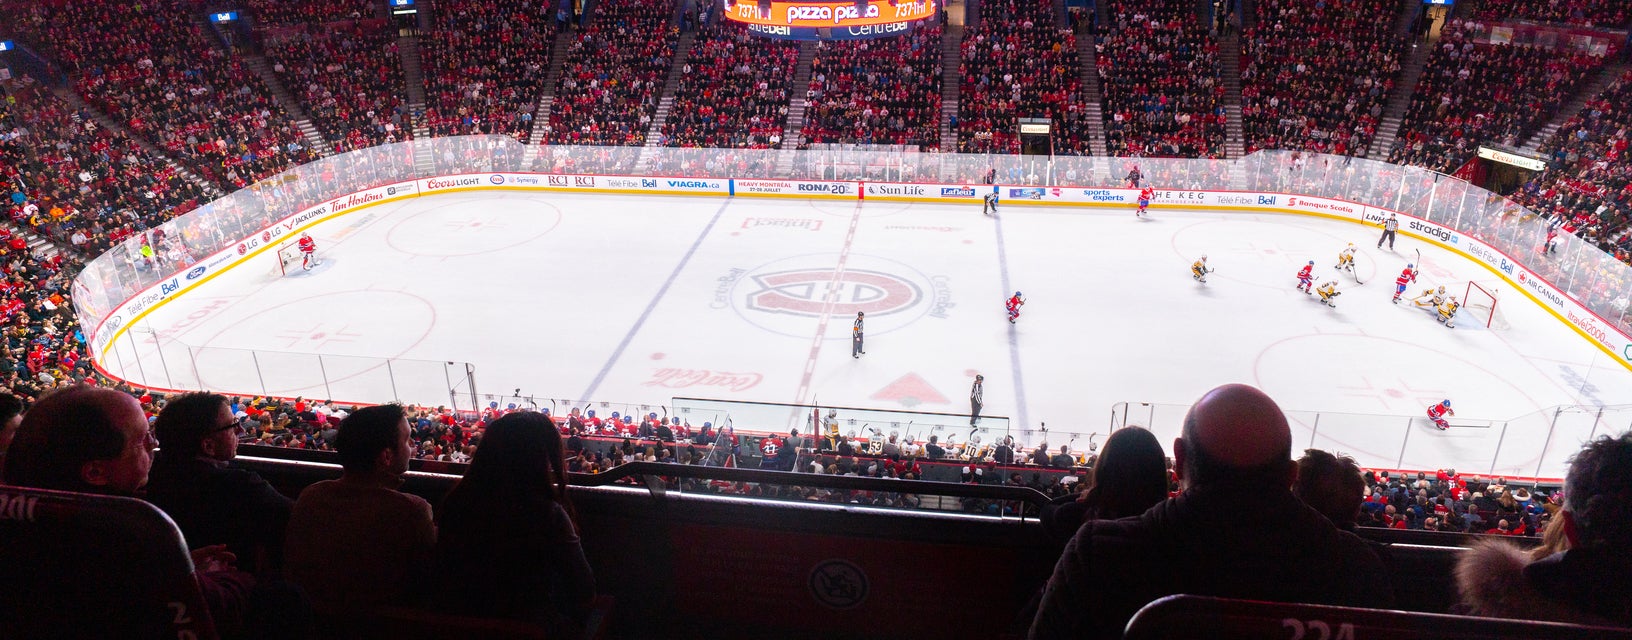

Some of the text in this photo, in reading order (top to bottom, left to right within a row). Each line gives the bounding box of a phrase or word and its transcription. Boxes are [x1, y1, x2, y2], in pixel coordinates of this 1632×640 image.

[218, 13, 231, 21] Bell
[787, 6, 879, 24] pizza piza
[426, 177, 480, 189] Coors LIGHT
[548, 176, 568, 184] RCI
[575, 177, 595, 186] RCI
[608, 179, 657, 188] Télé Fibe Bell
[798, 184, 830, 192] RONA
[832, 185, 846, 194] 20
[880, 186, 924, 195] Sun Life
[942, 188, 974, 196] Lafleur
[330, 192, 383, 212] Tim Hortons
[1235, 196, 1252, 204] Fibe
[1258, 196, 1276, 205] Bell
[1299, 200, 1354, 213] Banque Scotia
[271, 227, 282, 238] LG
[1409, 220, 1452, 242] stradigi
[247, 238, 258, 250] LG
[1468, 242, 1514, 275] Télé Fibe Bell
[127, 278, 180, 316] Télé Fibe Bell
[1526, 278, 1564, 308] AIR CANADA
[1567, 310, 1616, 351] itravel2000.com
[870, 441, 881, 452] 53
[966, 446, 977, 457] 10
